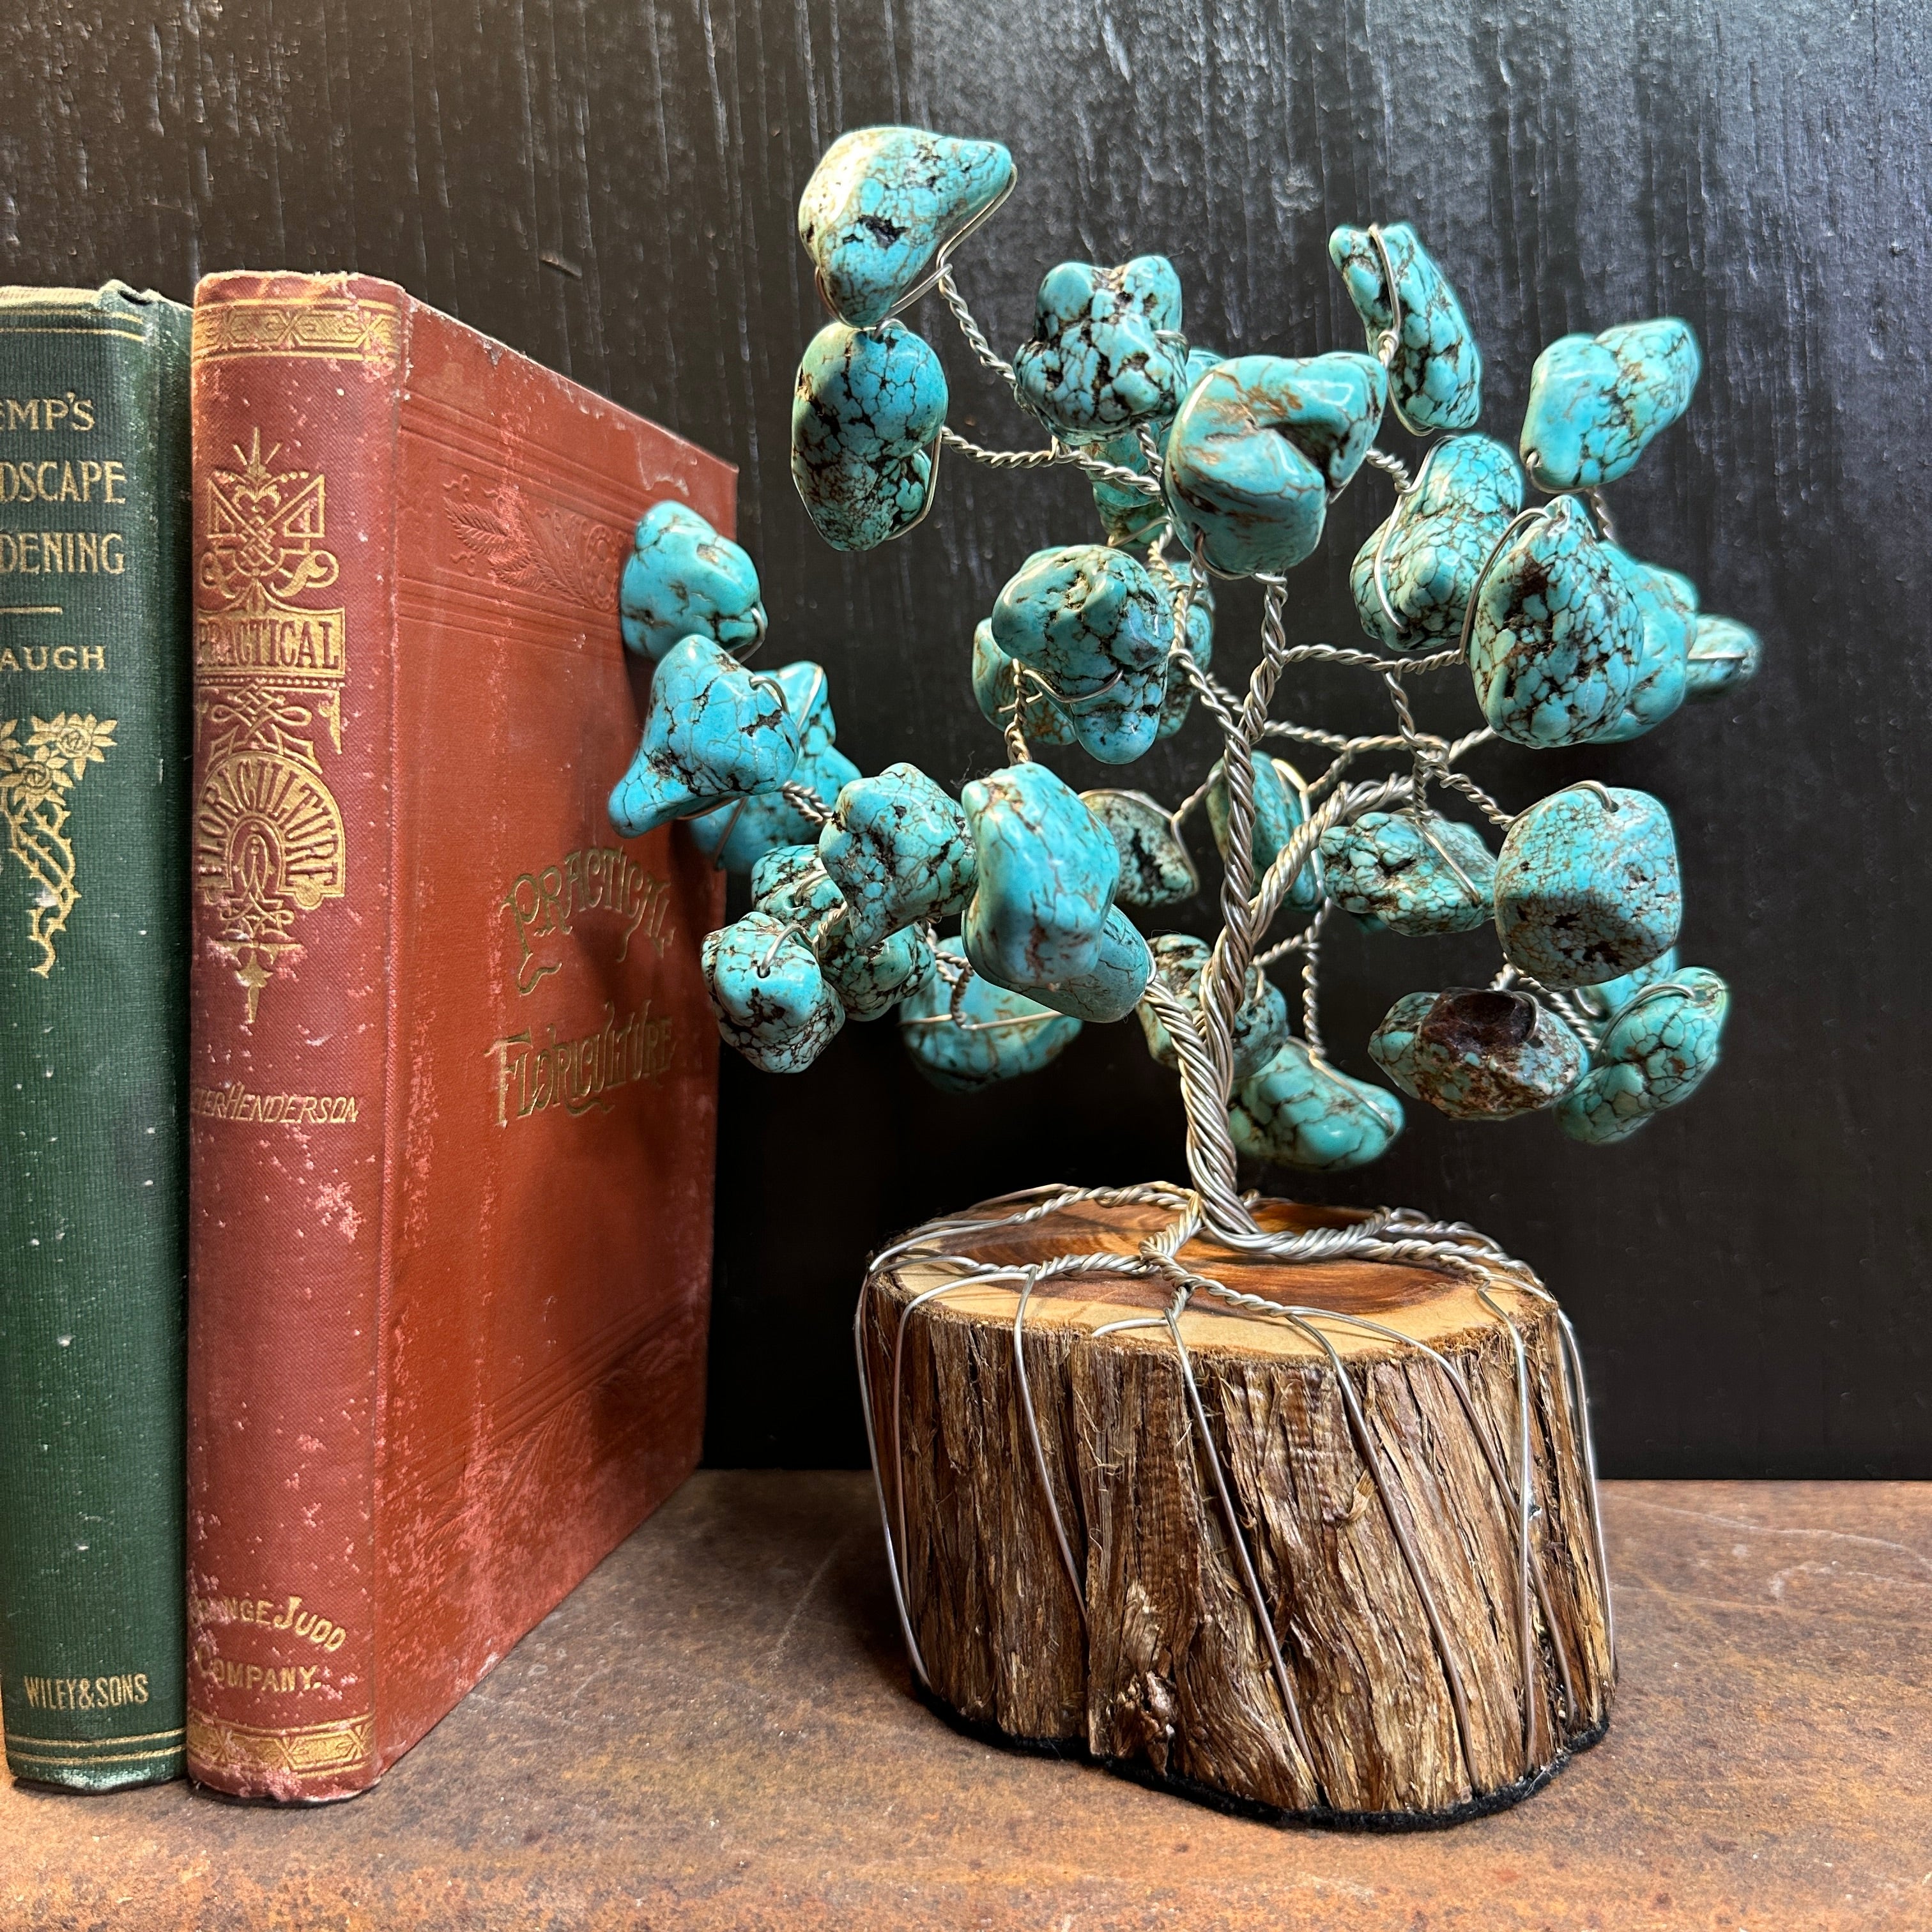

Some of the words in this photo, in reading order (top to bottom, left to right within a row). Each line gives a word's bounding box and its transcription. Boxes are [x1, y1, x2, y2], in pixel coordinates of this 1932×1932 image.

[0, 391, 95, 432] MP'S
[0, 459, 126, 504] DSCAPE
[0, 532, 125, 574] DENING
[0, 645, 107, 671] AUGH
